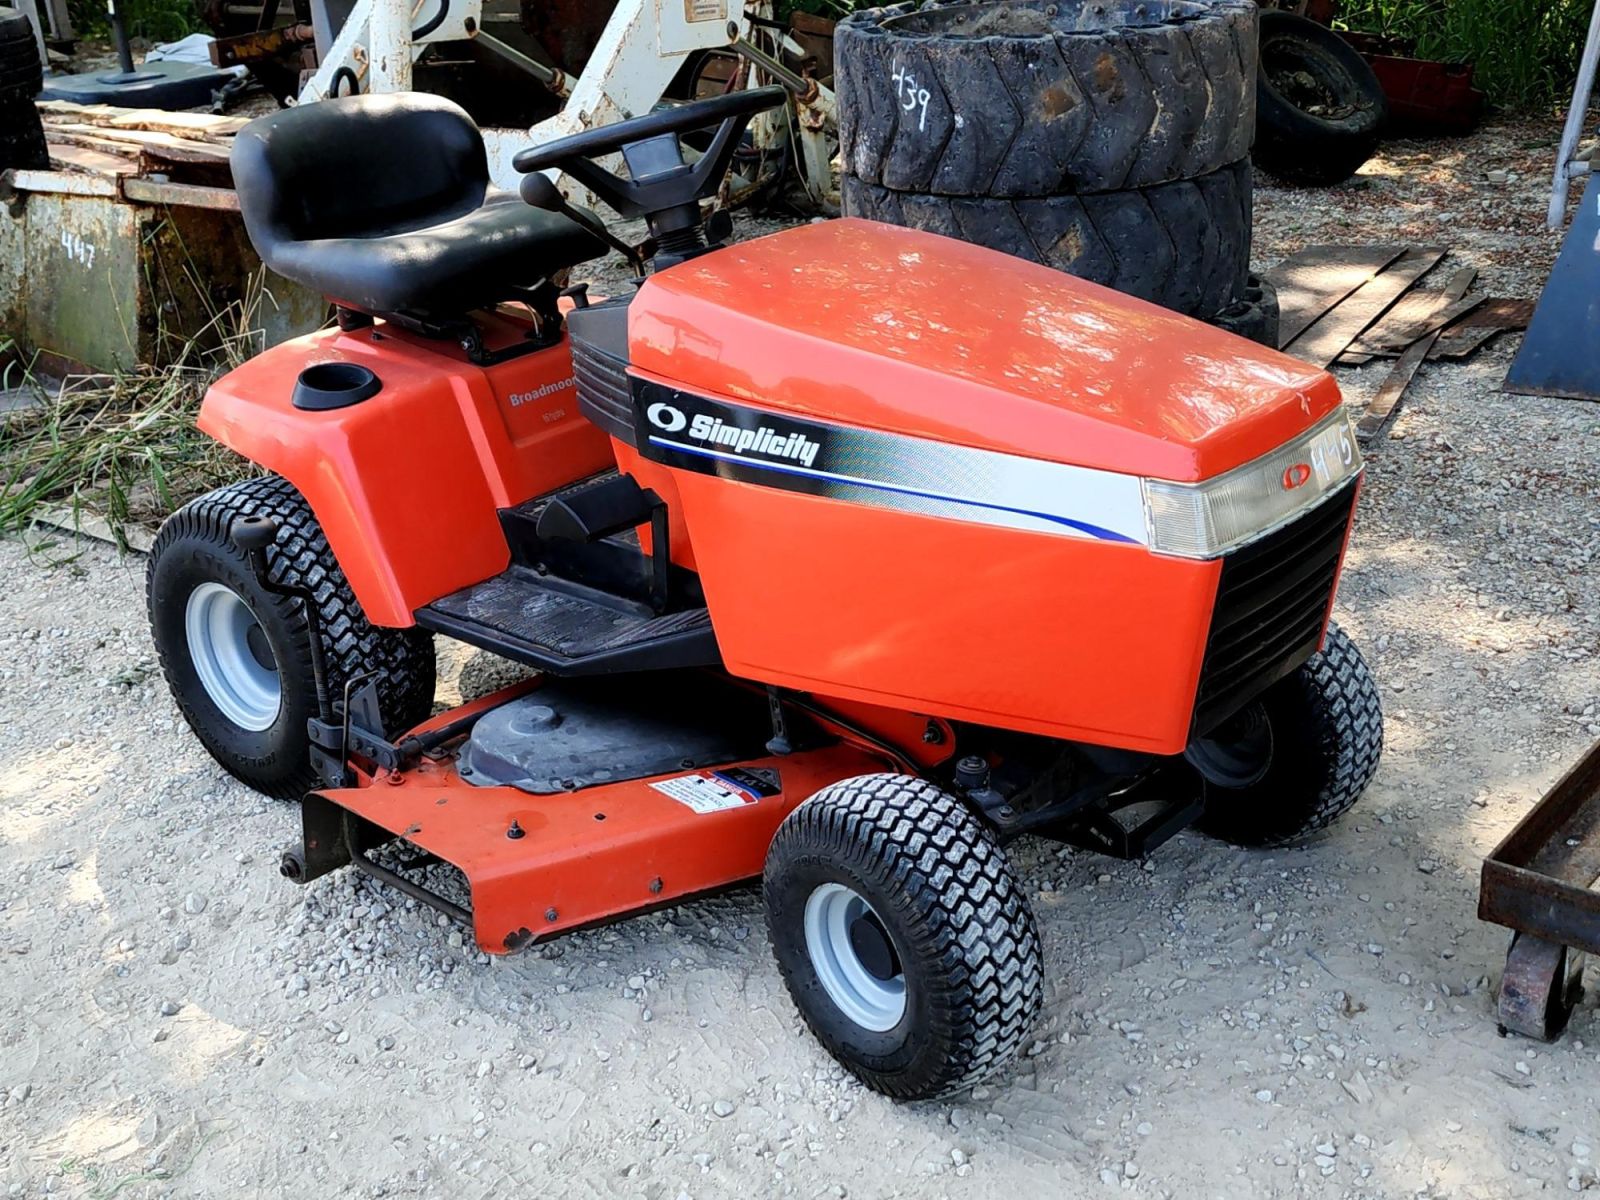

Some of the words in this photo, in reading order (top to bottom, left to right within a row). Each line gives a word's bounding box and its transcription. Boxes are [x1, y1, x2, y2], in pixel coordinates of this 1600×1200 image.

[62, 230, 95, 269] 447
[508, 375, 577, 407] Broadmoor
[688, 413, 820, 467] Simplicity
